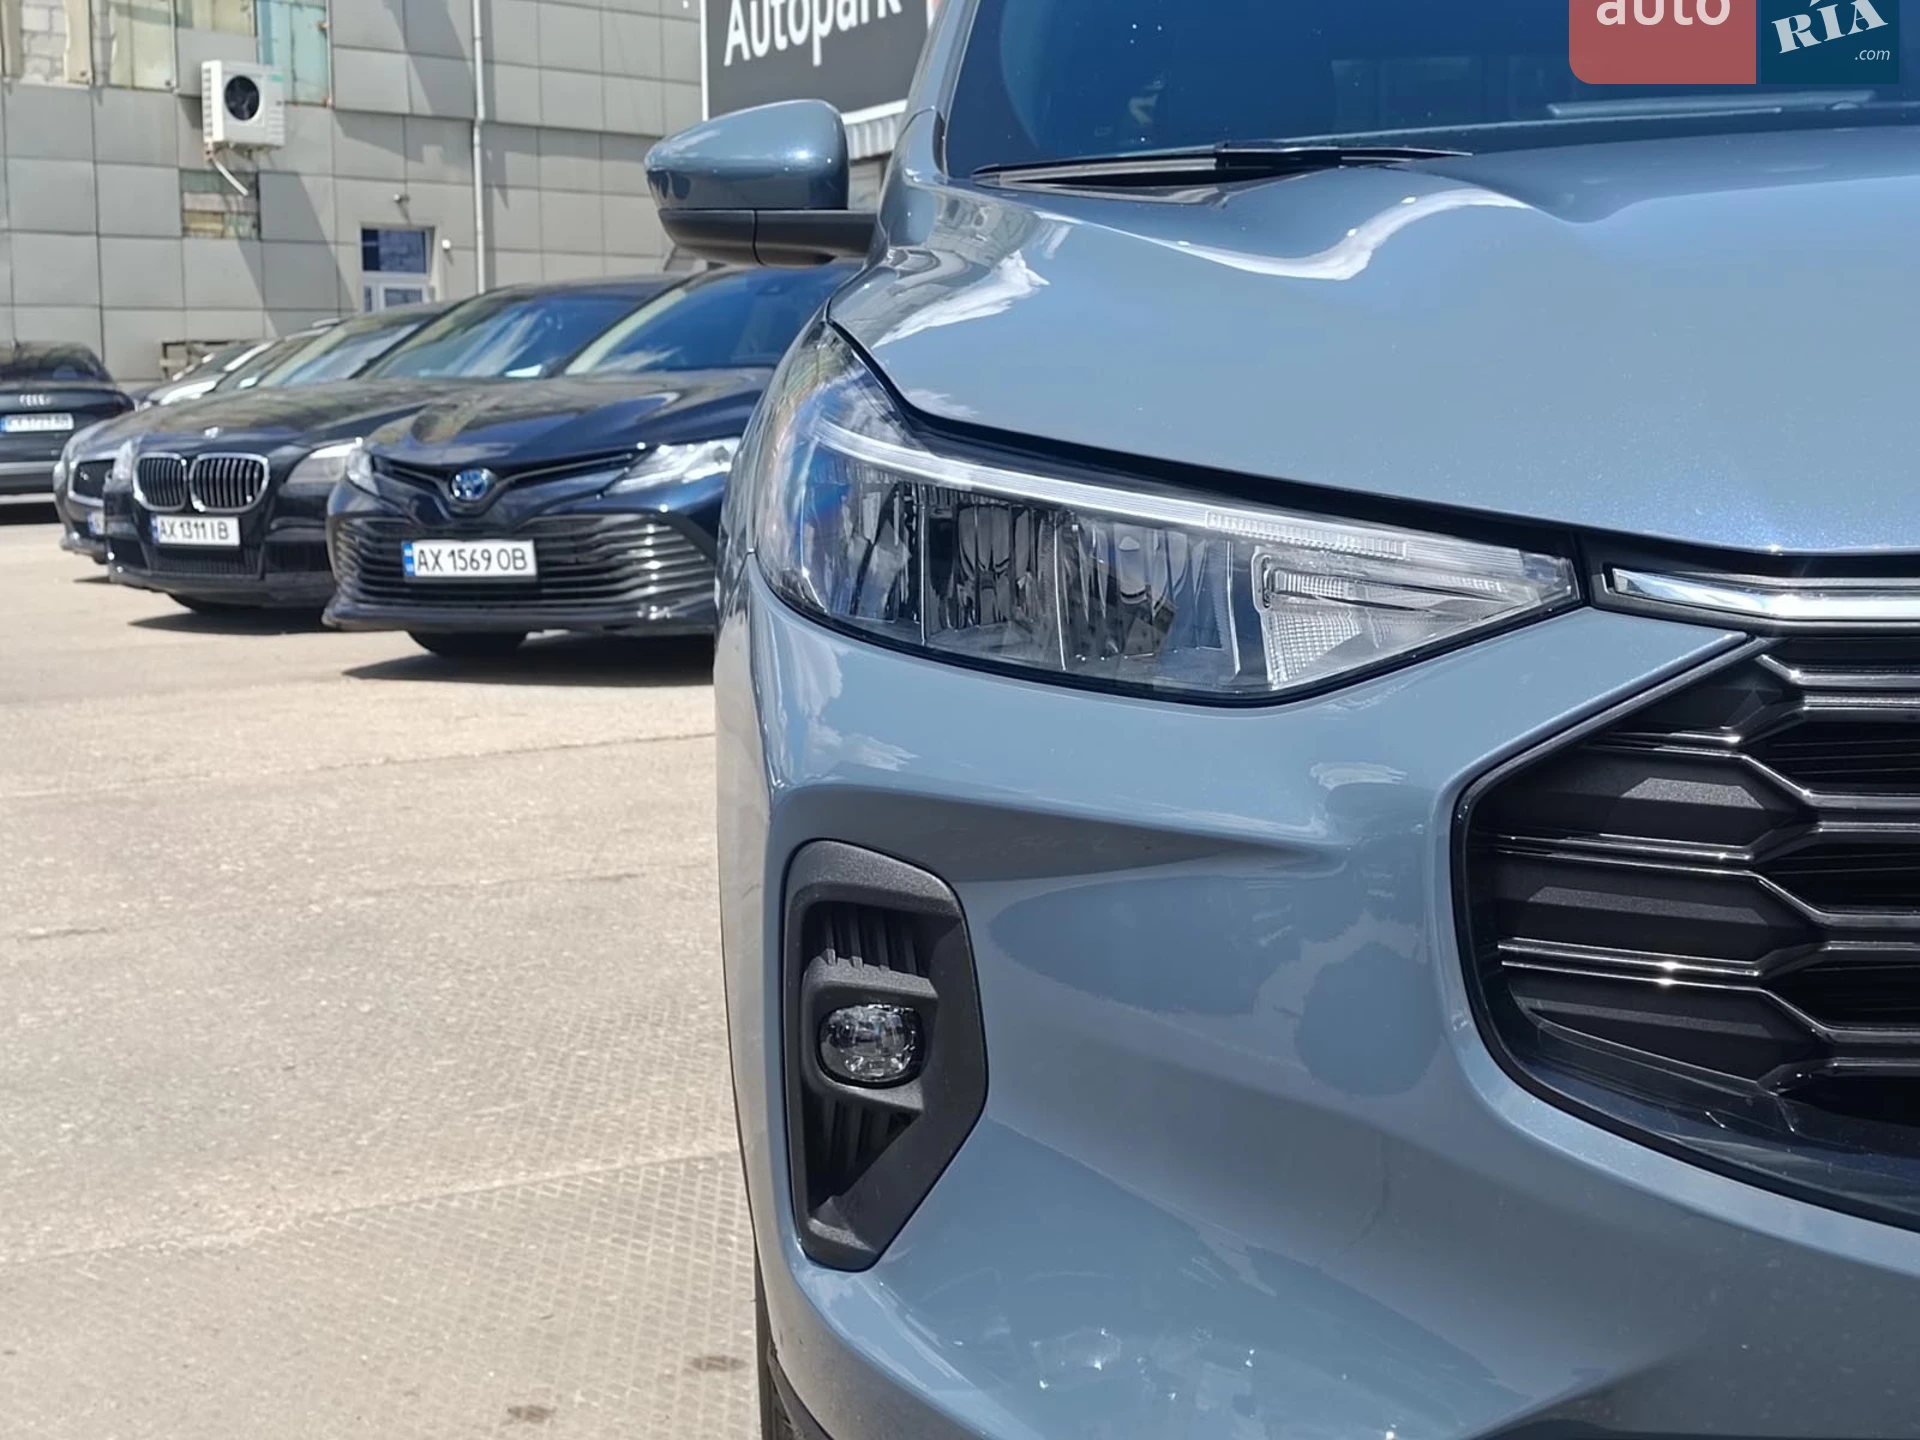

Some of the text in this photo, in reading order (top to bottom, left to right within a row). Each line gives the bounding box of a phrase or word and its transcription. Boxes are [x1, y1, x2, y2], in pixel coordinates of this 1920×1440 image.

[723, 0, 903, 67] Autopa
[417, 547, 528, 572] AX 1569 OB
